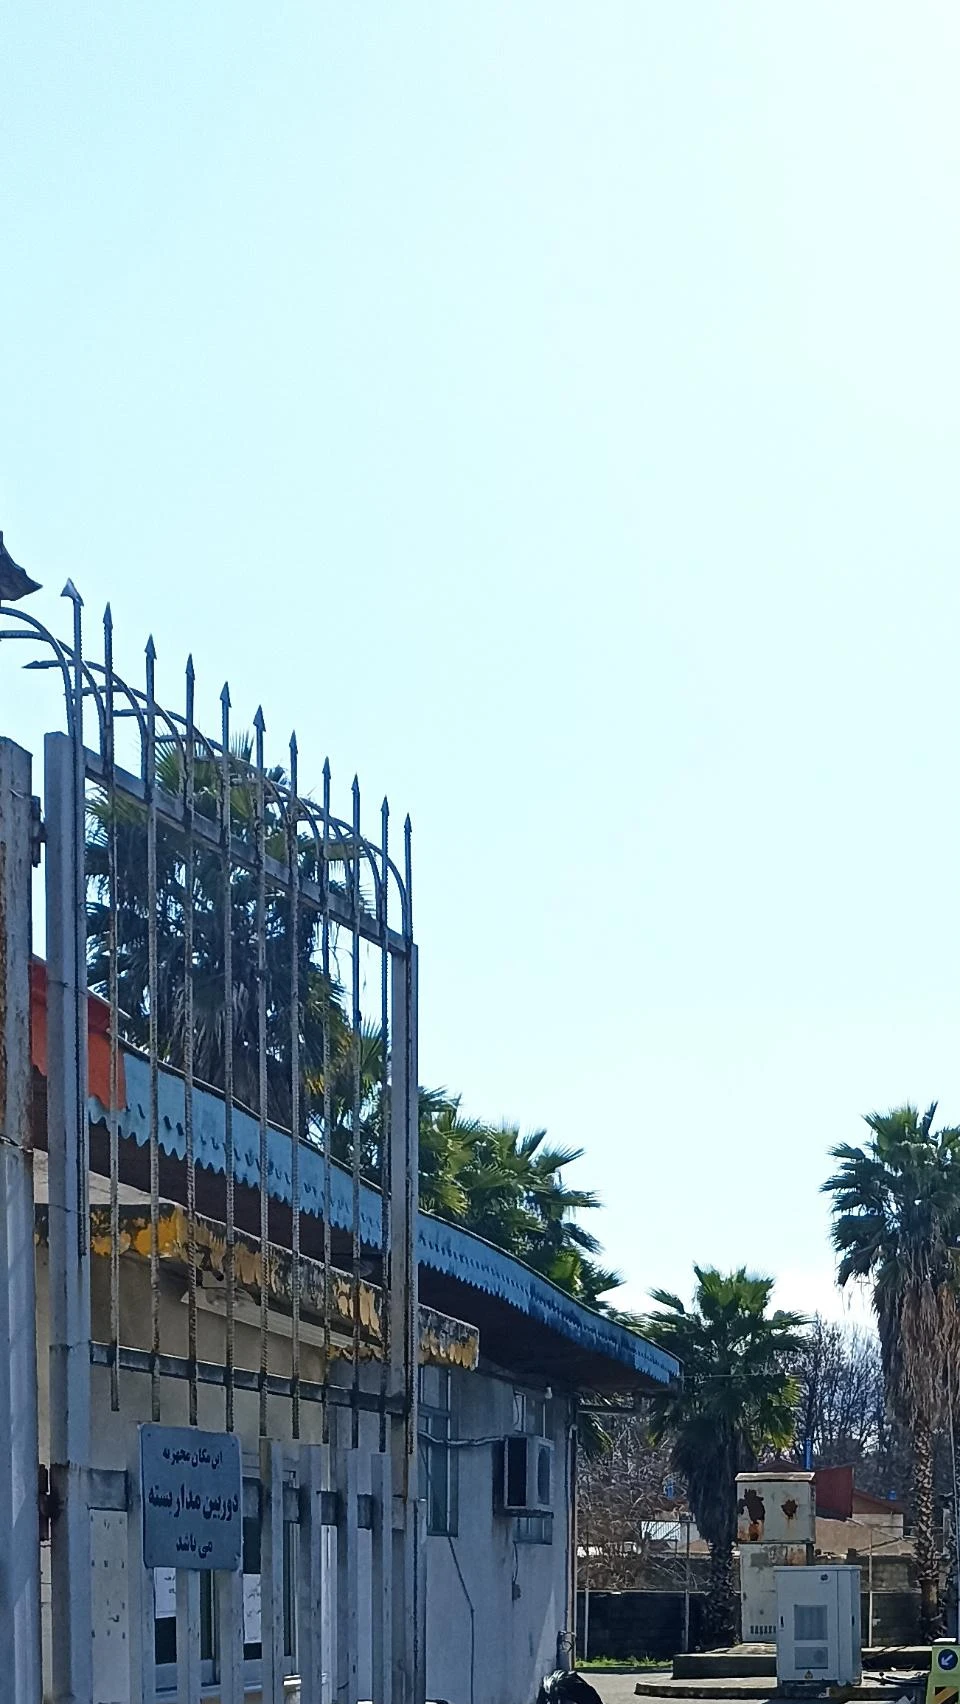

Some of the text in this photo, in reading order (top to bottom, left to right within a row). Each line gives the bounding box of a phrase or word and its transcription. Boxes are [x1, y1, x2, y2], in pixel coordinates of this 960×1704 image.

[191, 1448, 210, 1468] مکان
[148, 1483, 239, 1521] دوربین مدار بسته
[176, 1534, 213, 1559] می باشد
